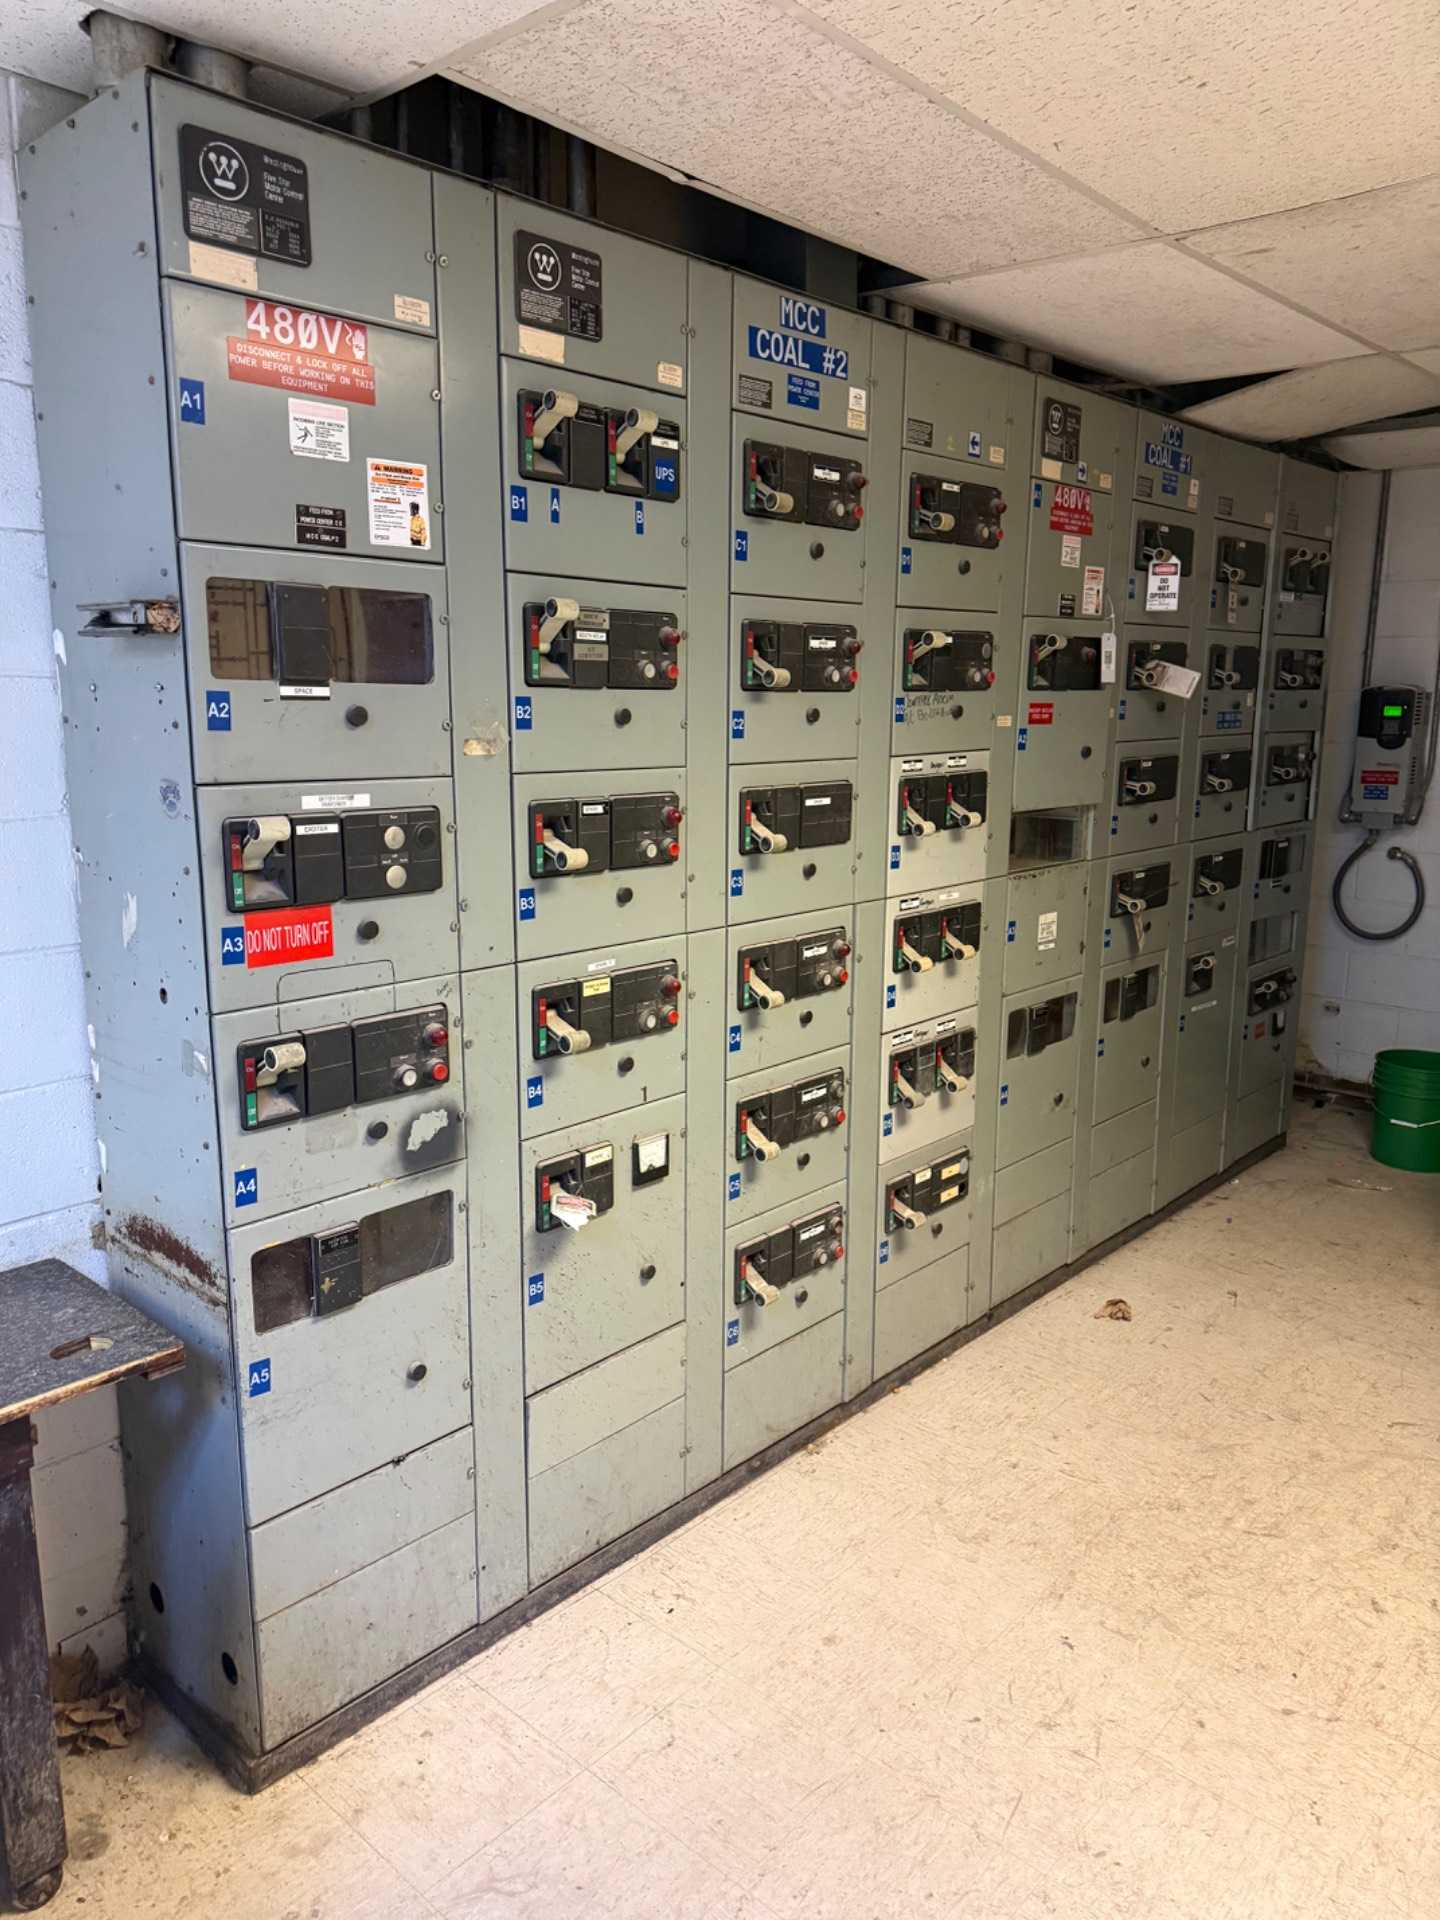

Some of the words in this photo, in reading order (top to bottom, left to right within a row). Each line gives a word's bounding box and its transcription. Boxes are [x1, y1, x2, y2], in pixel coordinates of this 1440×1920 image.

[781, 297, 820, 334] MCC
[235, 343, 292, 363] DISCONNECT
[306, 358, 328, 371] LOCK
[331, 363, 348, 374] OFF
[351, 367, 368, 378] ALL
[756, 329, 810, 369] COAL
[822, 343, 847, 377] #2
[229, 354, 257, 367] POWER
[262, 359, 294, 375] BEFORE
[300, 367, 336, 383] WORKING
[339, 375, 351, 385] ON
[355, 378, 375, 390] THIS
[281, 376, 329, 392] EQUIPMENT
[180, 393, 202, 412] A1
[1148, 444, 1174, 469] COAL
[655, 466, 675, 482] UPS
[511, 496, 526, 511] B1
[551, 498, 560, 512] A
[636, 511, 644, 524] B
[1159, 577, 1169, 585] DO
[1149, 592, 1177, 600] OPERATE
[207, 702, 230, 718] A2
[516, 705, 531, 719] B2
[732, 717, 745, 730] C2
[520, 896, 535, 910] B3
[222, 937, 244, 953] A3
[247, 930, 260, 954] DO
[262, 927, 282, 952] NOT
[285, 924, 311, 948] TURN
[311, 921, 329, 945] OFF
[528, 1084, 542, 1099] B4
[235, 1178, 257, 1196] A4
[528, 1281, 544, 1296] B5
[250, 1368, 270, 1385] A5
